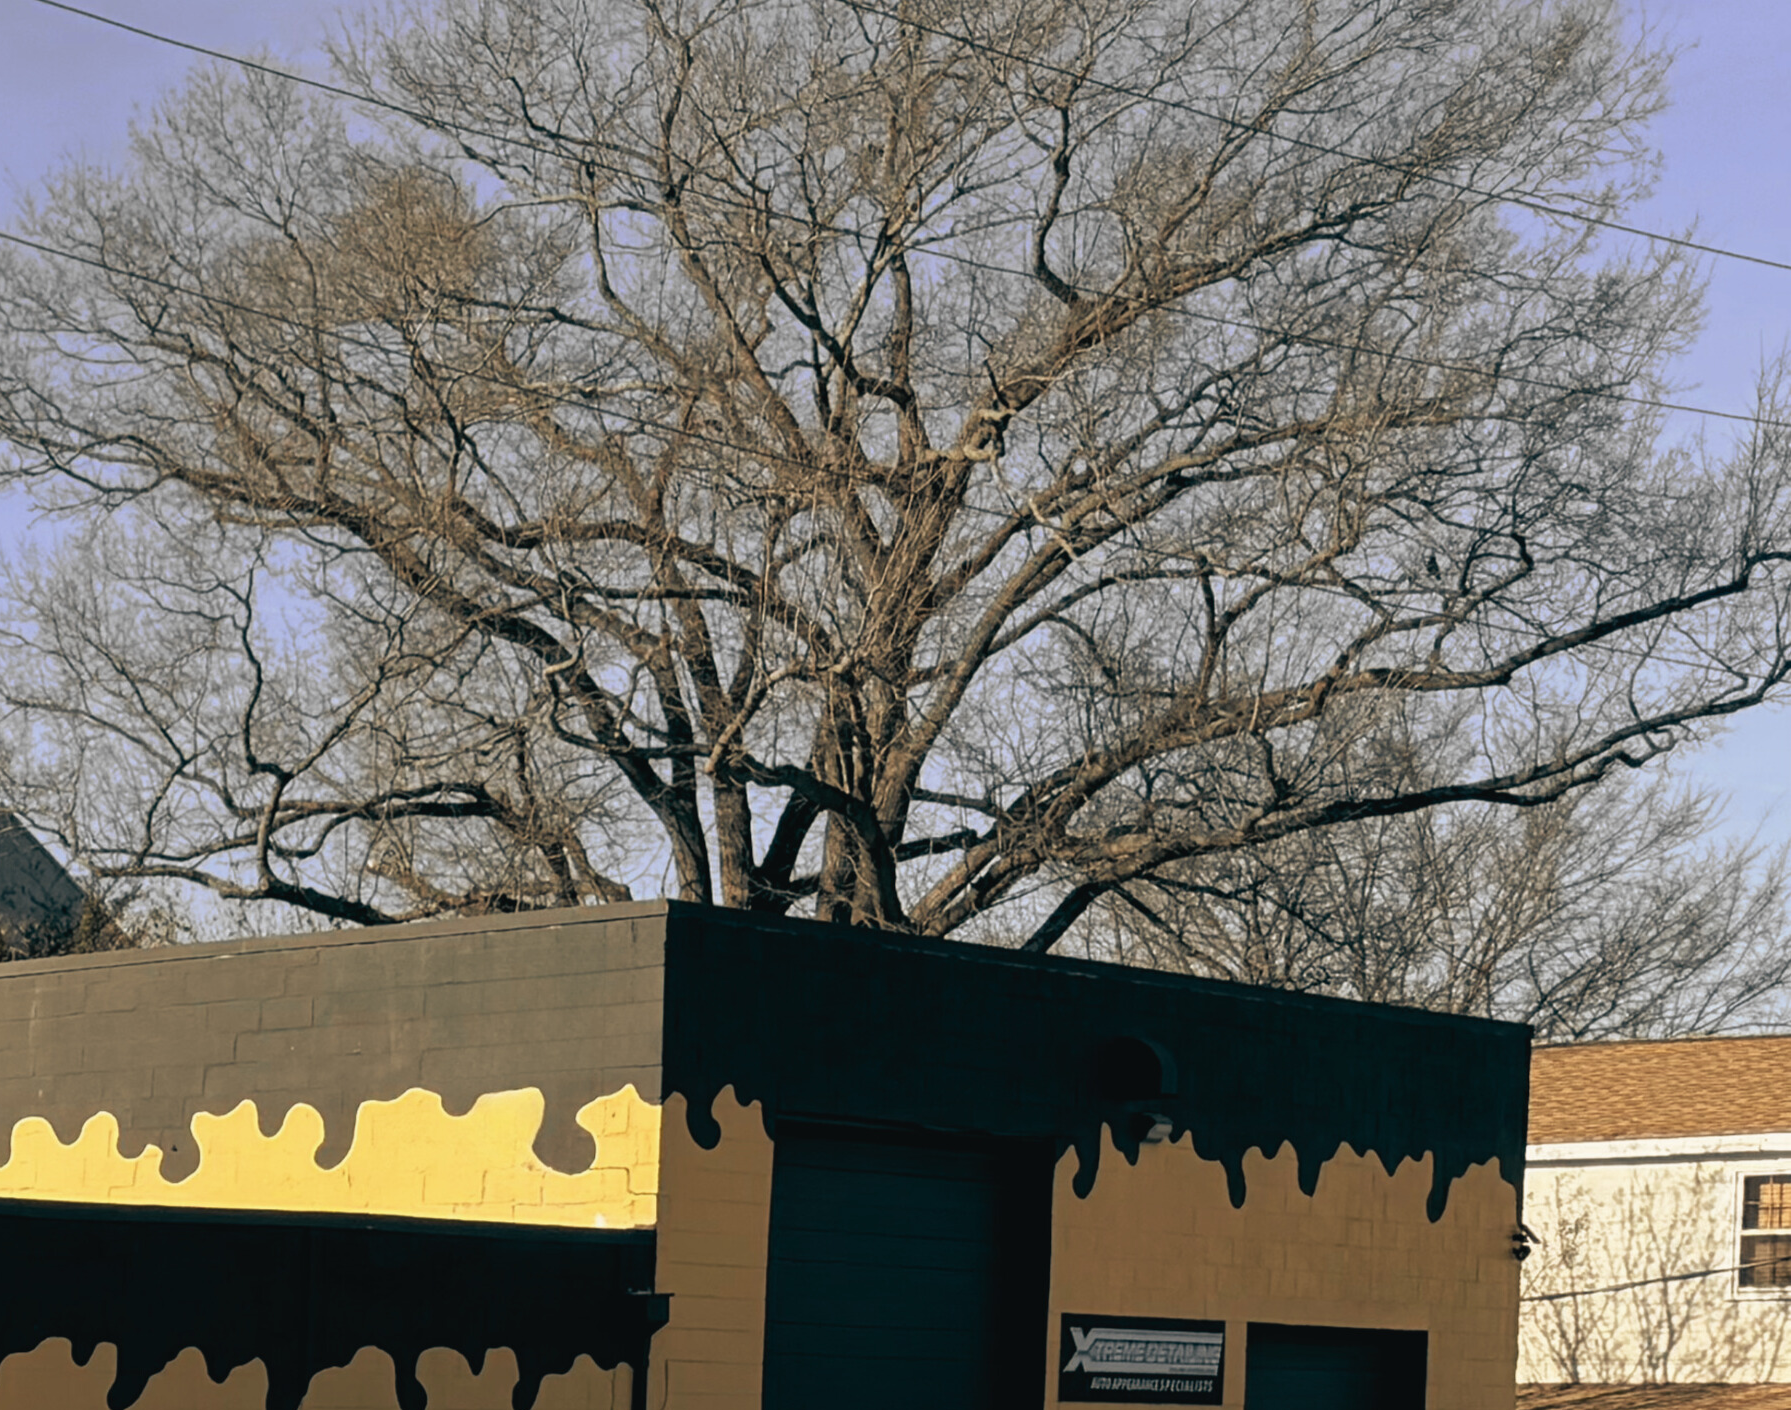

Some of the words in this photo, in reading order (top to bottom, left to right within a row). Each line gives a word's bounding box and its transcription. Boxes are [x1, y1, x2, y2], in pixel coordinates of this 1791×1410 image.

[1091, 1377, 1111, 1389] AUTO
[1111, 1378, 1158, 1391] APPEARANCE
[1159, 1379, 1213, 1392] SPECIALISTS
